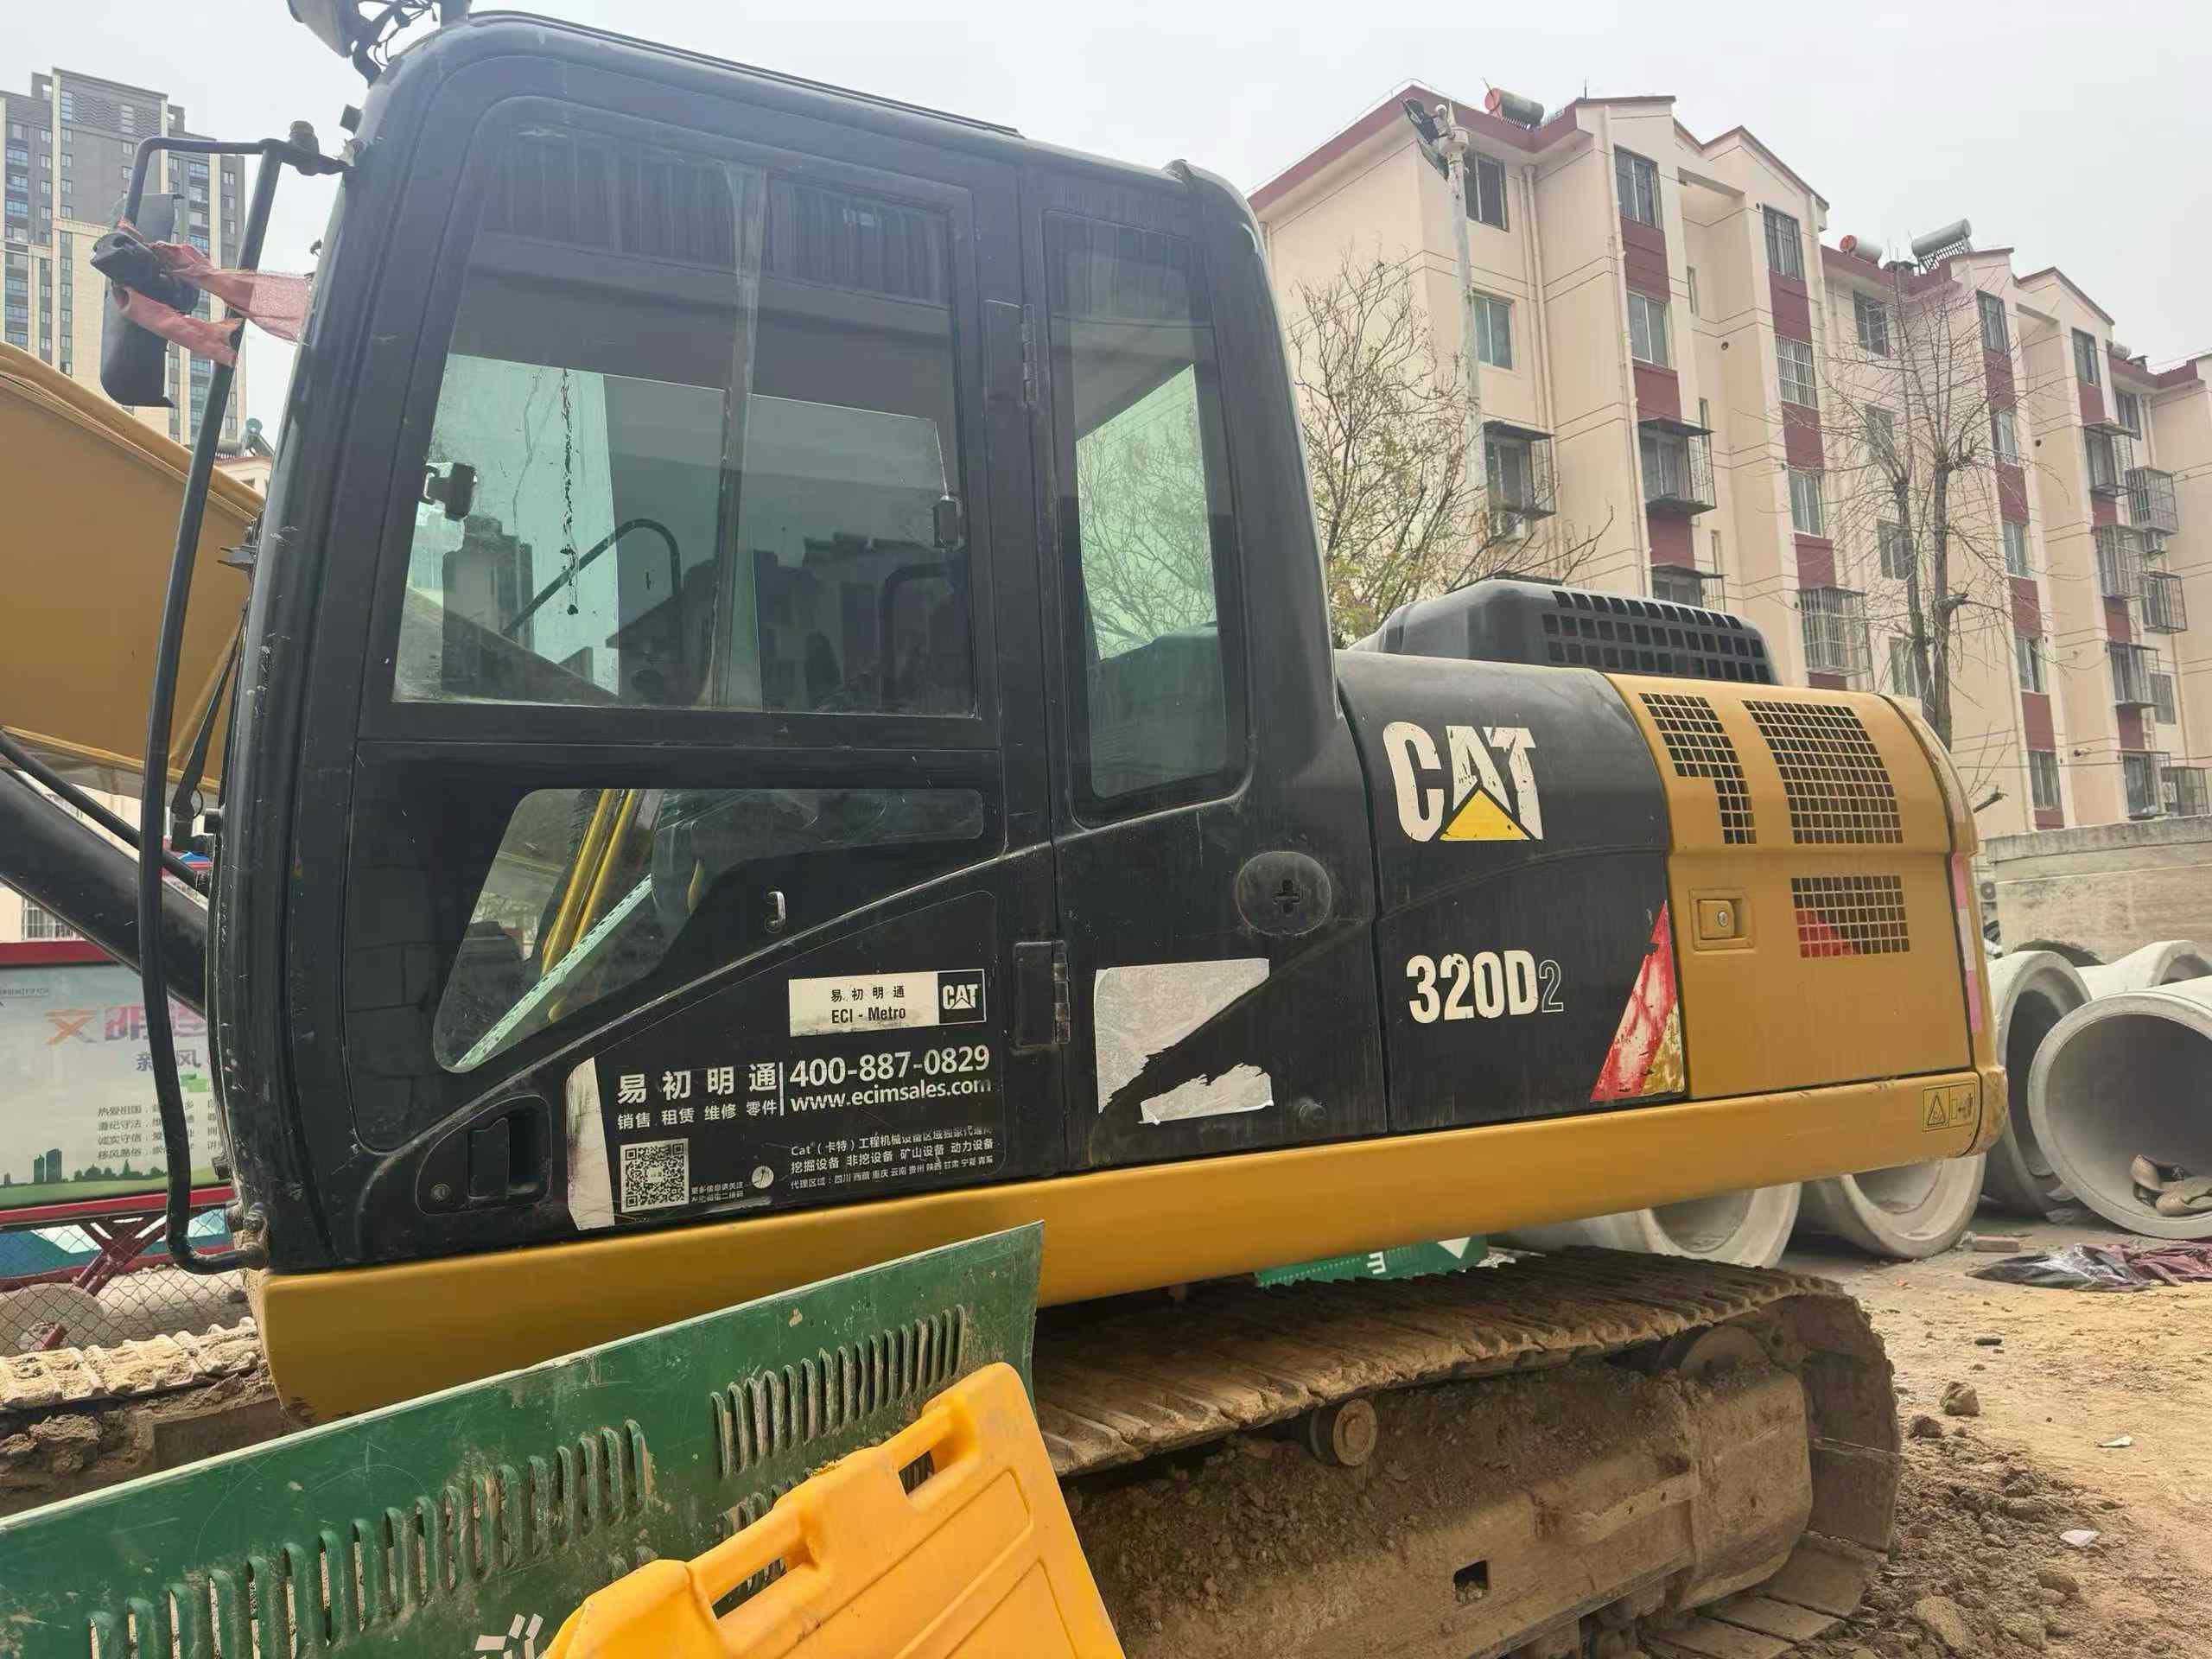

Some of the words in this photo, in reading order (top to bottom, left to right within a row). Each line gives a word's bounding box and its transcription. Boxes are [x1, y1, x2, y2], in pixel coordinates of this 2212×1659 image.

[1382, 721, 1543, 842] CAT
[830, 985, 905, 1002] 易初明通
[943, 983, 979, 1009] CAT
[1407, 950, 1563, 1023] 320D2
[831, 1009, 854, 1024] ECI
[868, 1006, 906, 1021] Metro
[789, 1045, 990, 1087] 400-887-0829
[617, 1063, 778, 1104] 易初明通
[790, 1079, 992, 1112] www.ecimsales.com
[617, 1112, 651, 1130] 销售
[661, 1107, 696, 1126] 租赁
[704, 1103, 737, 1121] 维修
[746, 1098, 778, 1116] 零件
[791, 1158, 839, 1174] 挖掘设备
[846, 1151, 893, 1166] 非挖设备
[900, 1144, 945, 1160] 矿山设备
[950, 1138, 994, 1154] 动力设备
